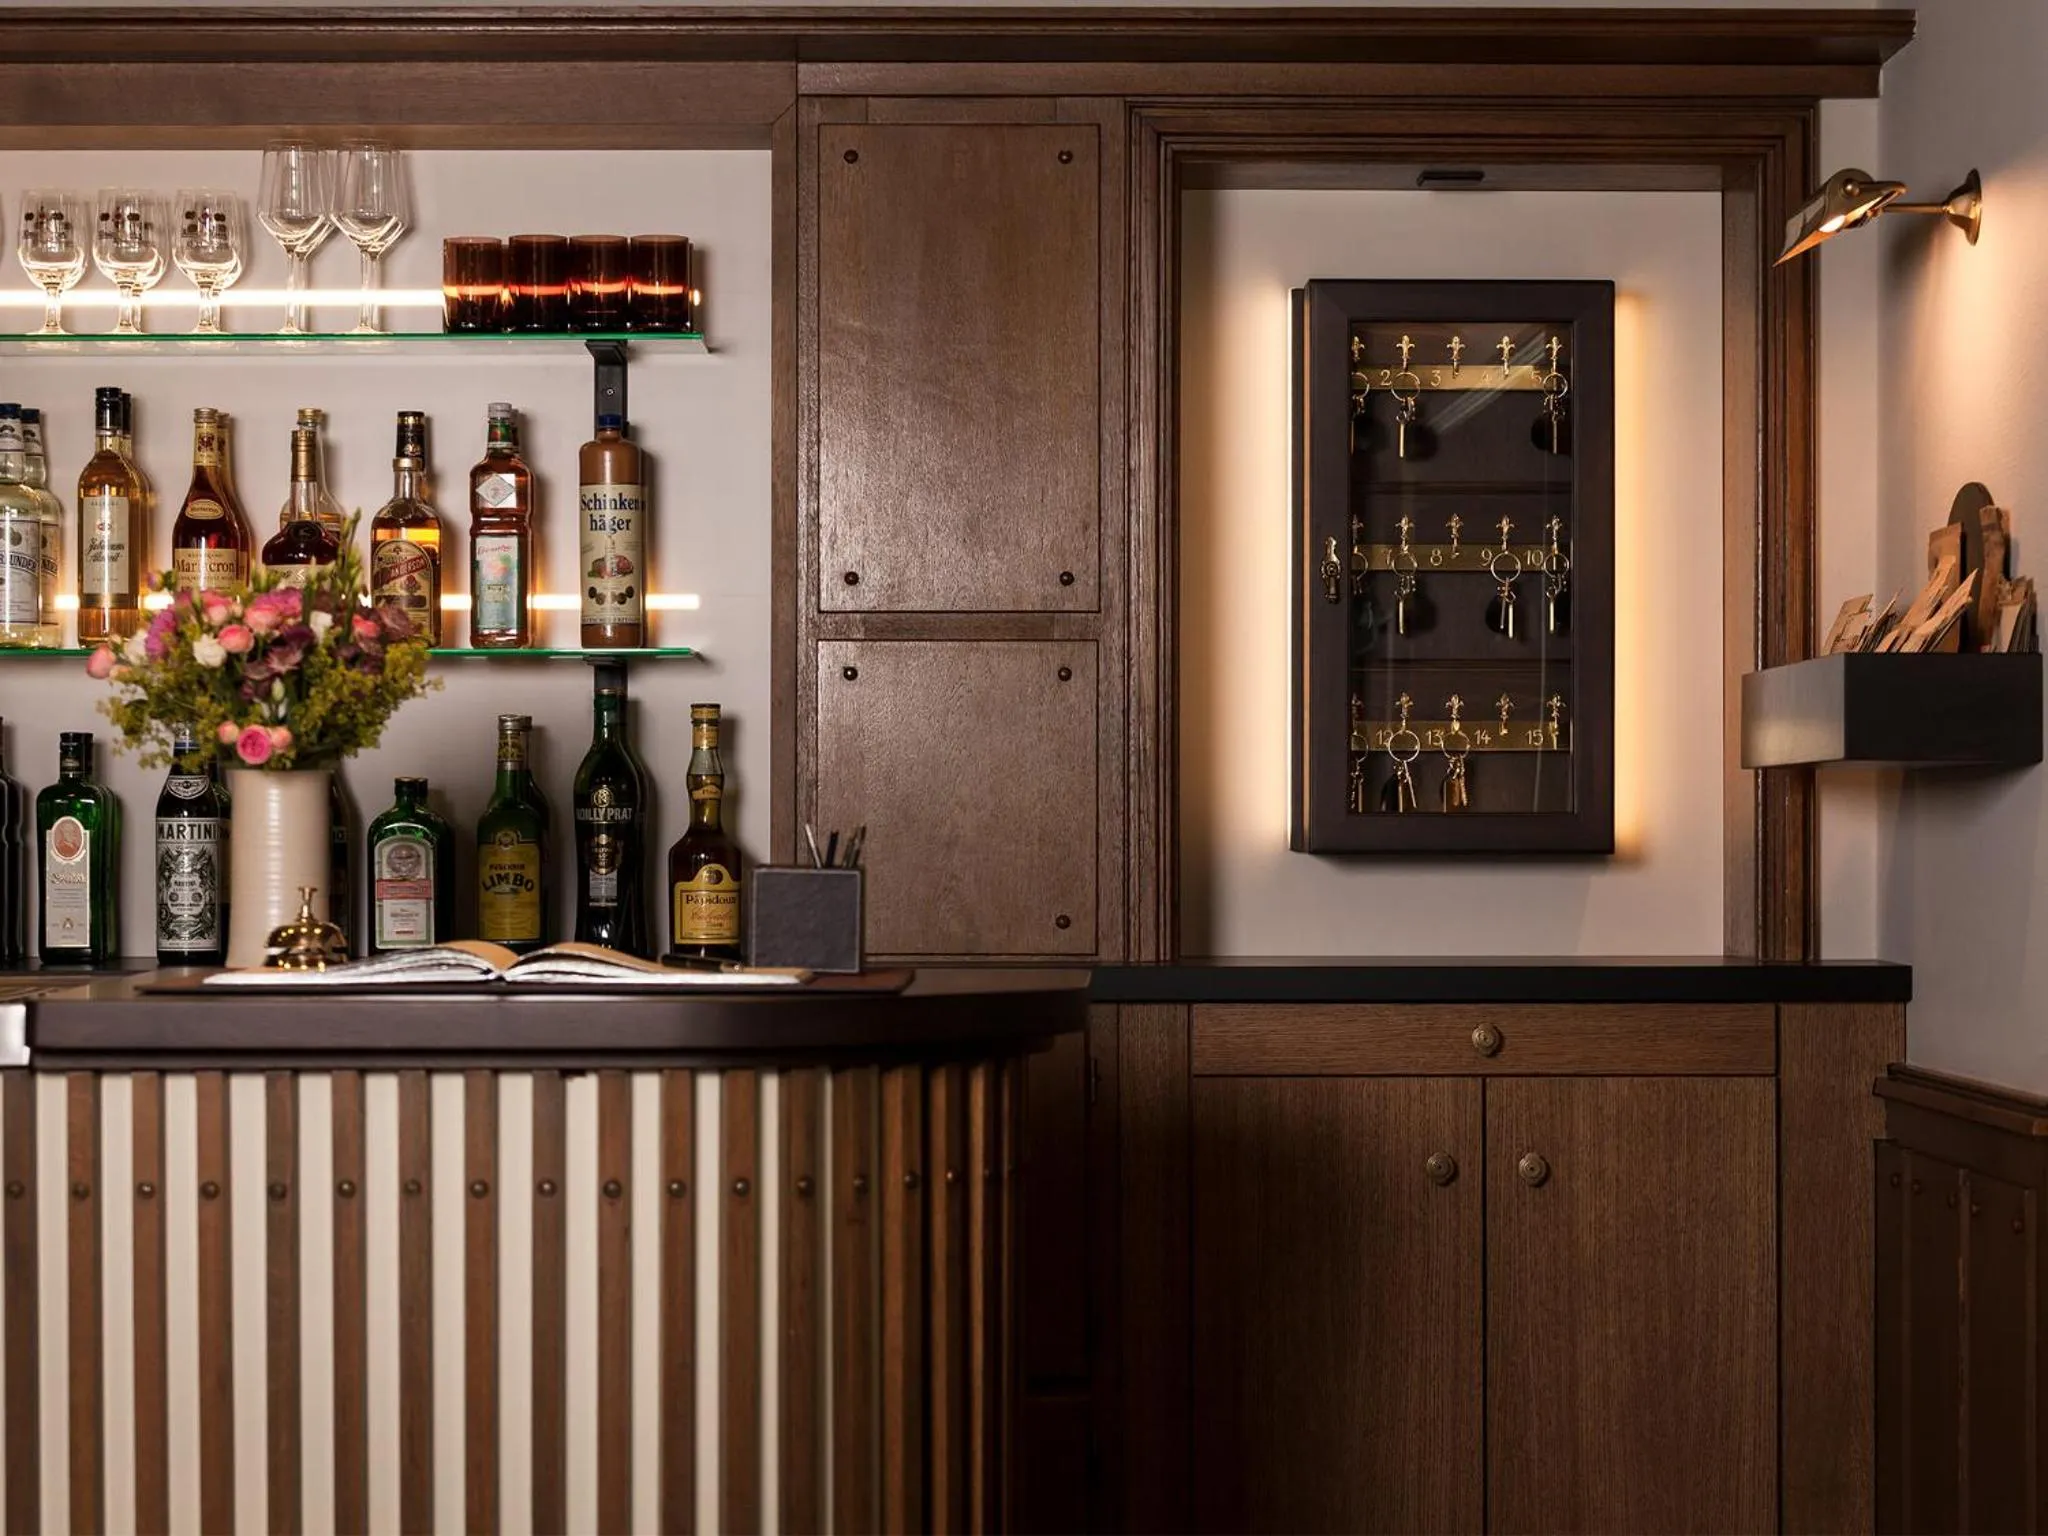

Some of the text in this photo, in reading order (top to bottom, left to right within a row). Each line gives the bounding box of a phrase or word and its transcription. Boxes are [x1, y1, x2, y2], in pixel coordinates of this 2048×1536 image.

[1380, 369, 1542, 387] 2 3 4 5
[590, 513, 632, 534] häger
[175, 559, 236, 573] Marcron
[1430, 549, 1442, 566] 8
[1480, 549, 1493, 566] 9
[1524, 549, 1544, 566] 10
[1376, 728, 1543, 745] 12 13 14 15
[607, 807, 633, 820] PRAT
[157, 823, 216, 840] MARTINI
[482, 872, 534, 892] LIMBO
